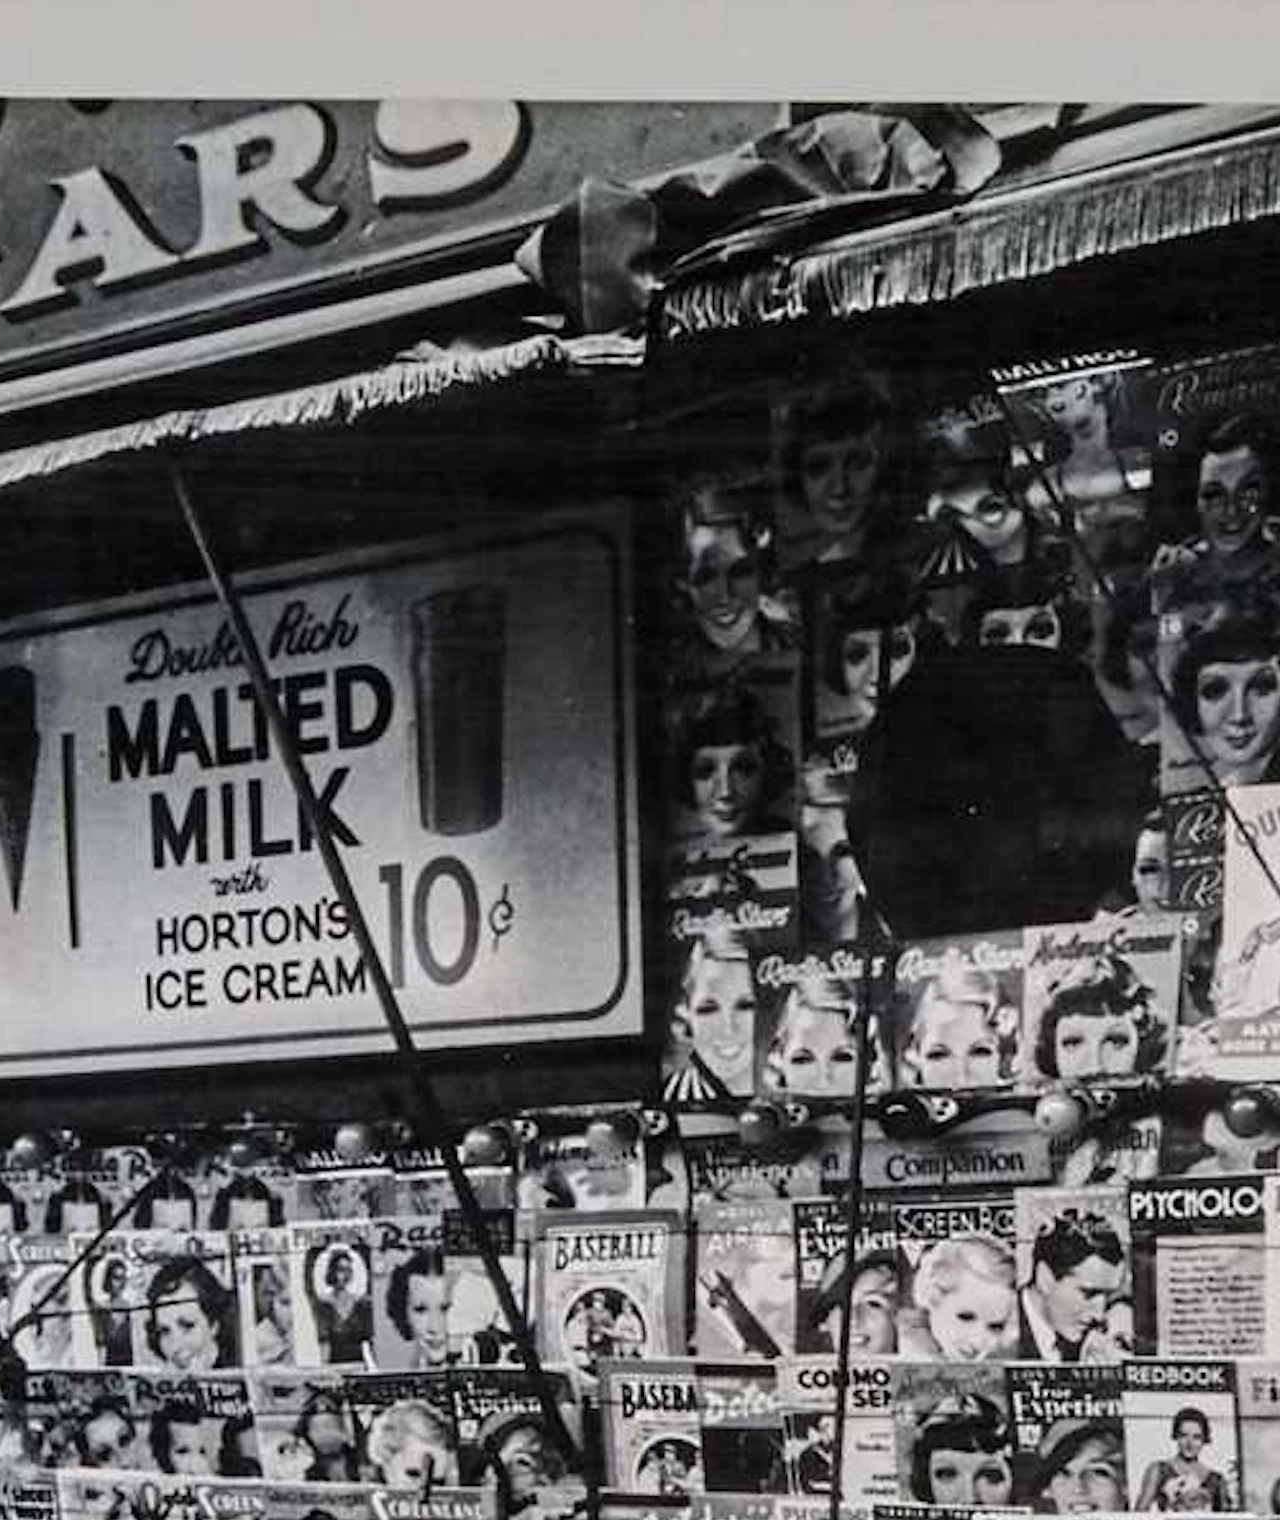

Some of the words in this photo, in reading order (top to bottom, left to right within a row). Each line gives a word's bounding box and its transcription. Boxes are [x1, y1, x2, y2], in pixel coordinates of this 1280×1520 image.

[269, 593, 360, 660] Rich
[107, 663, 394, 782] MALTED
[151, 766, 361, 872] MILK
[156, 894, 355, 957] HORTON'S
[146, 964, 207, 1014] ICE
[223, 957, 370, 1004] CREAM
[821, 948, 886, 982] Stas
[886, 1151, 1025, 1184] Companion
[554, 1232, 659, 1271] BASEBALL
[1125, 1366, 1226, 1385] REDBOOK
